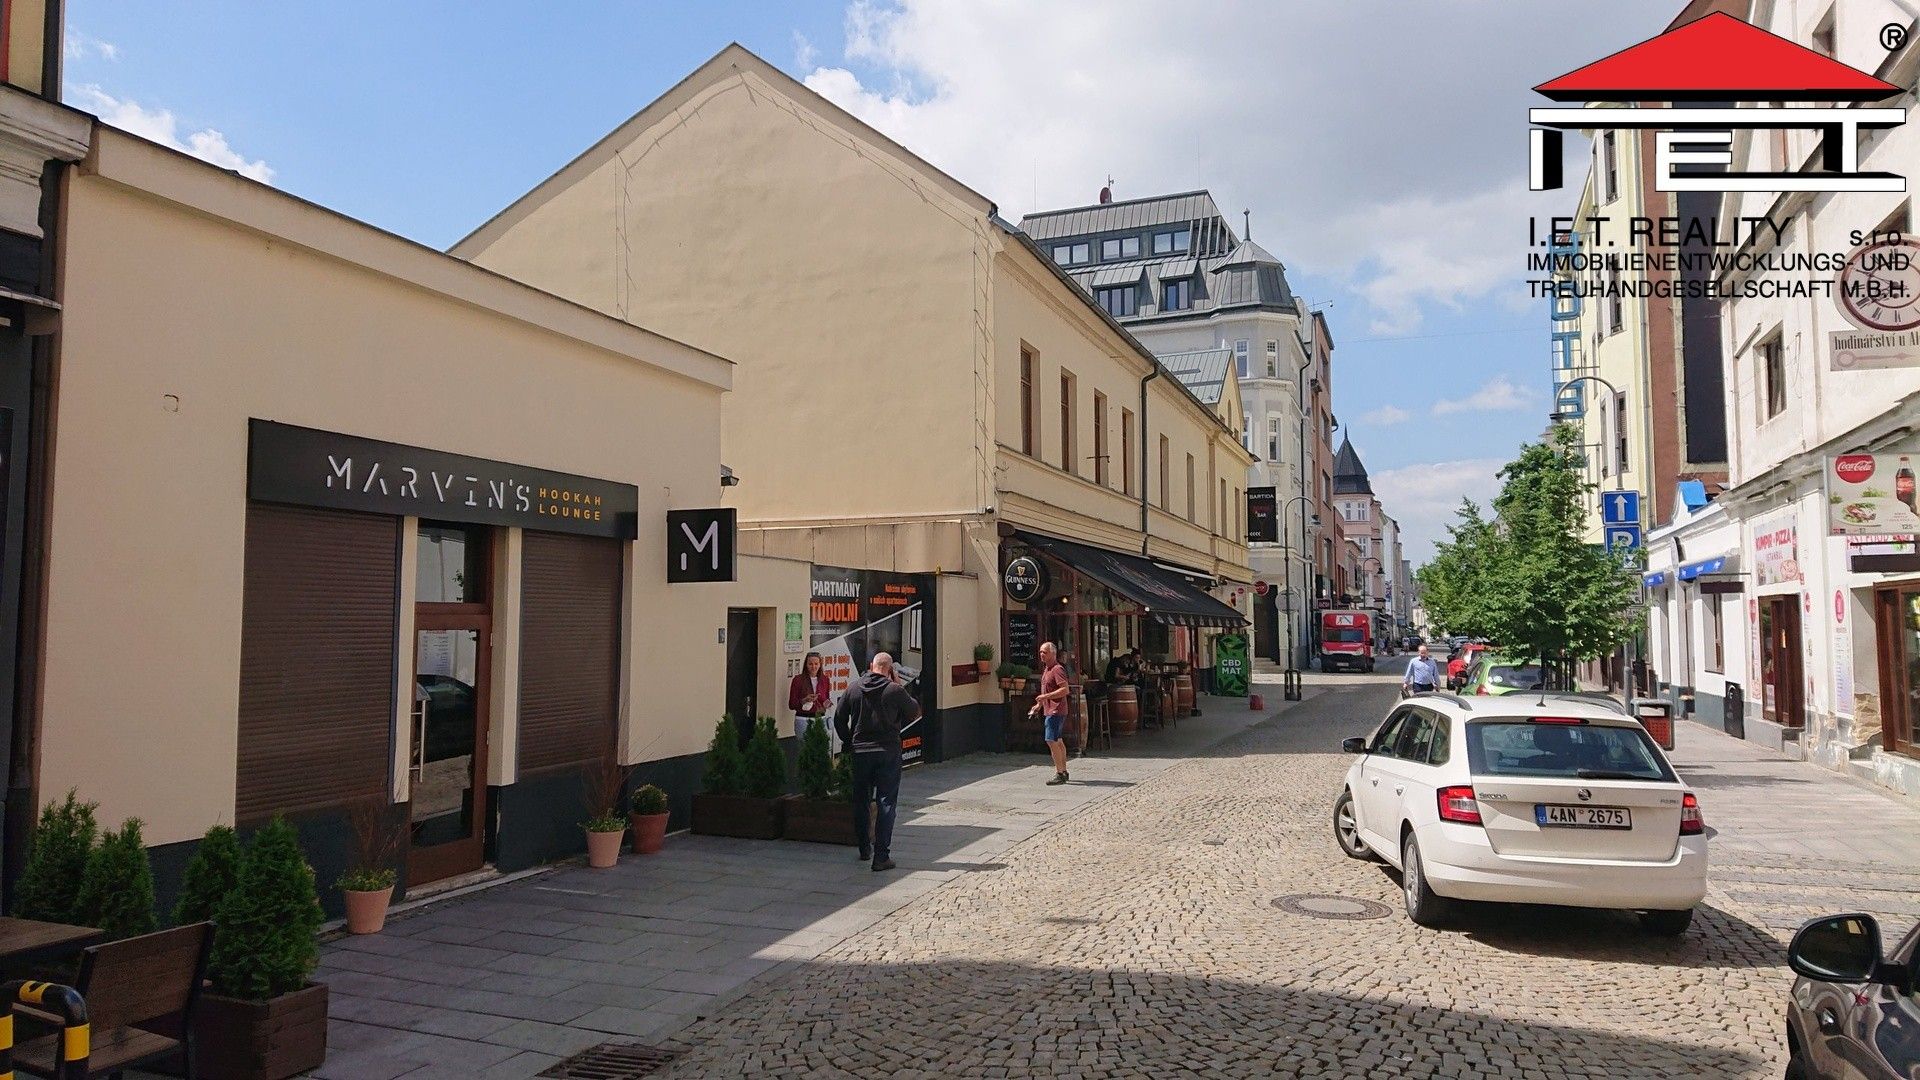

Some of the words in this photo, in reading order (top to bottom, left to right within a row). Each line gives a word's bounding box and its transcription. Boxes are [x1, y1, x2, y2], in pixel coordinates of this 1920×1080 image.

[1834, 331, 1897, 351] hodinářství
[1899, 335, 1906, 347] u
[326, 455, 530, 512] MARVIN'S
[538, 487, 602, 505] HOOKAH
[538, 503, 601, 522] LOUNGE
[680, 520, 719, 571] M
[1776, 528, 1792, 547] PIZZA
[1006, 575, 1037, 585] GUINNESS
[1221, 659, 1242, 667] CBD
[1221, 667, 1242, 675] MAT
[1550, 807, 1577, 823] 4AN
[1587, 809, 1624, 824] 2675
